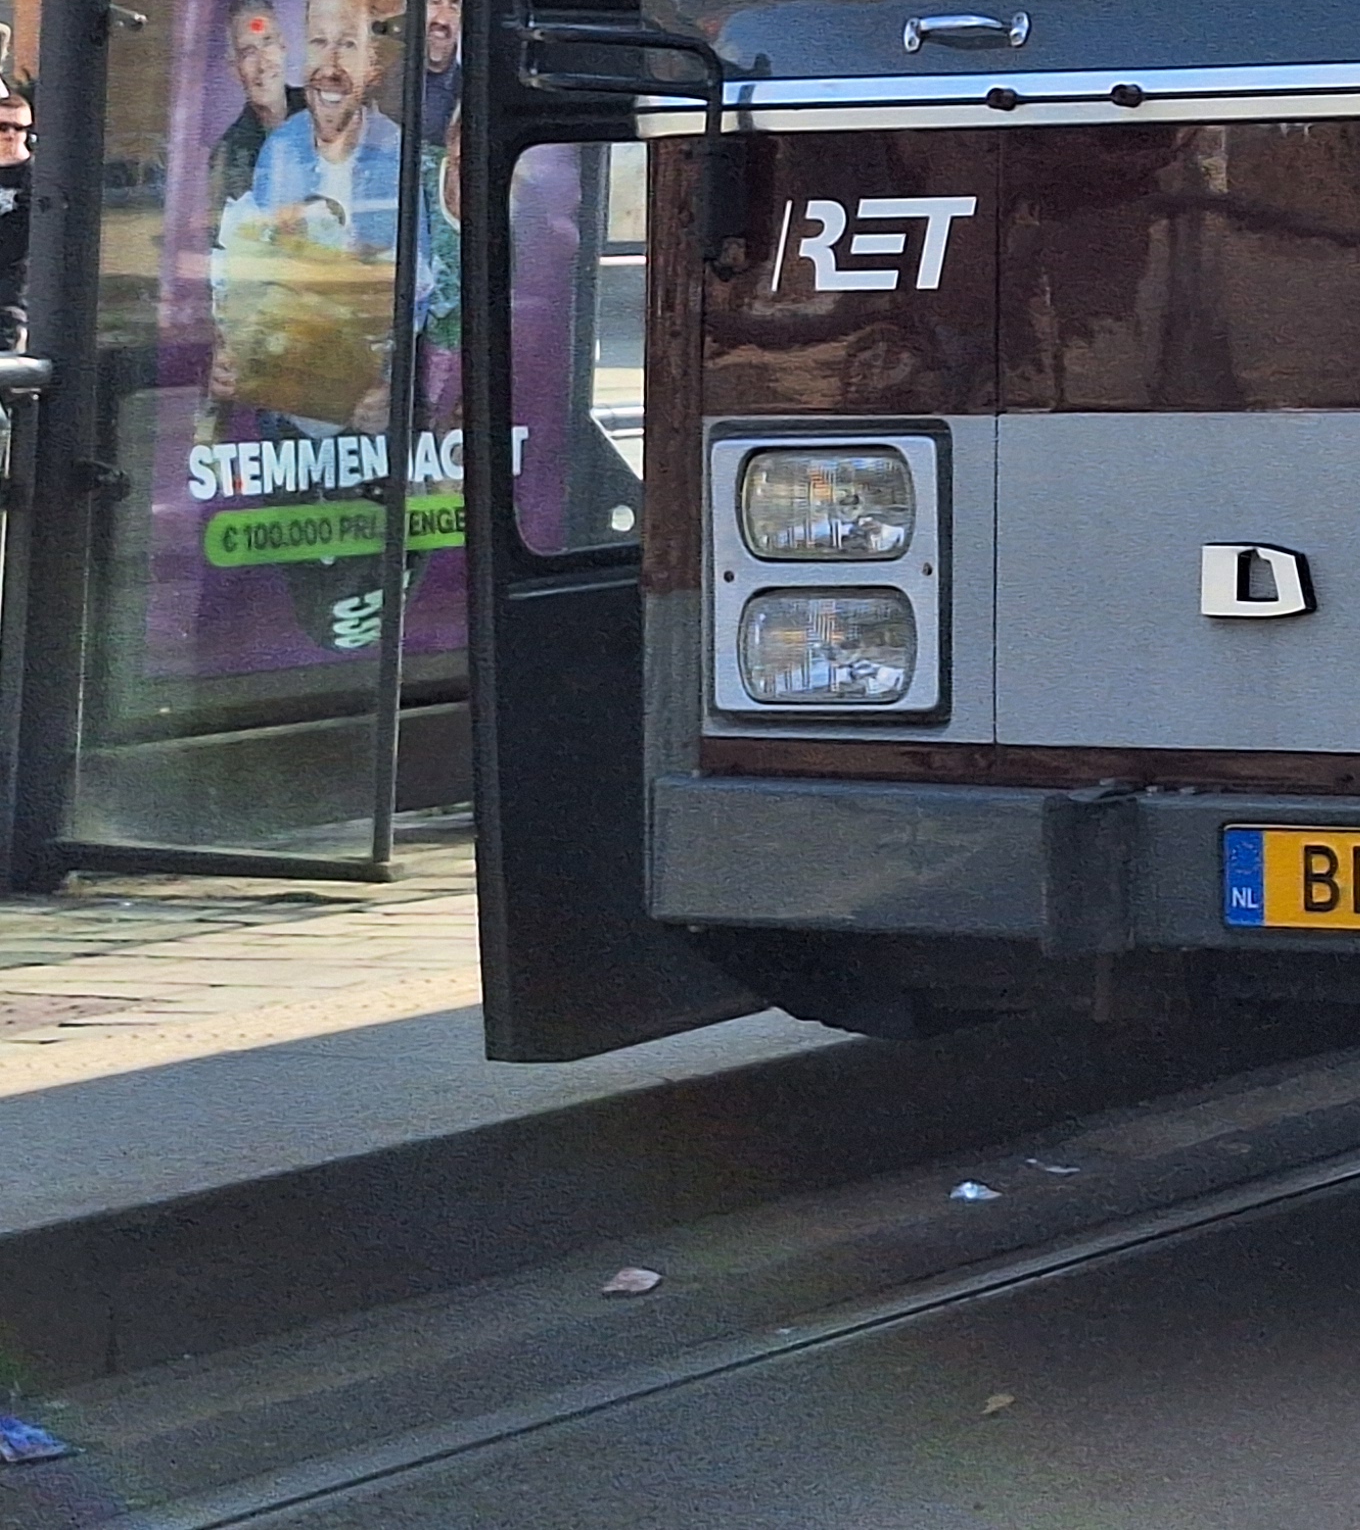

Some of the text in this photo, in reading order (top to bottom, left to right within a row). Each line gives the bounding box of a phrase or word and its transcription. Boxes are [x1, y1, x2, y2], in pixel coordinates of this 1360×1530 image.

[771, 197, 977, 291] RET
[187, 426, 529, 500] STEMMENACT
[243, 518, 332, 551] 100.000
[1231, 886, 1259, 909] NL
